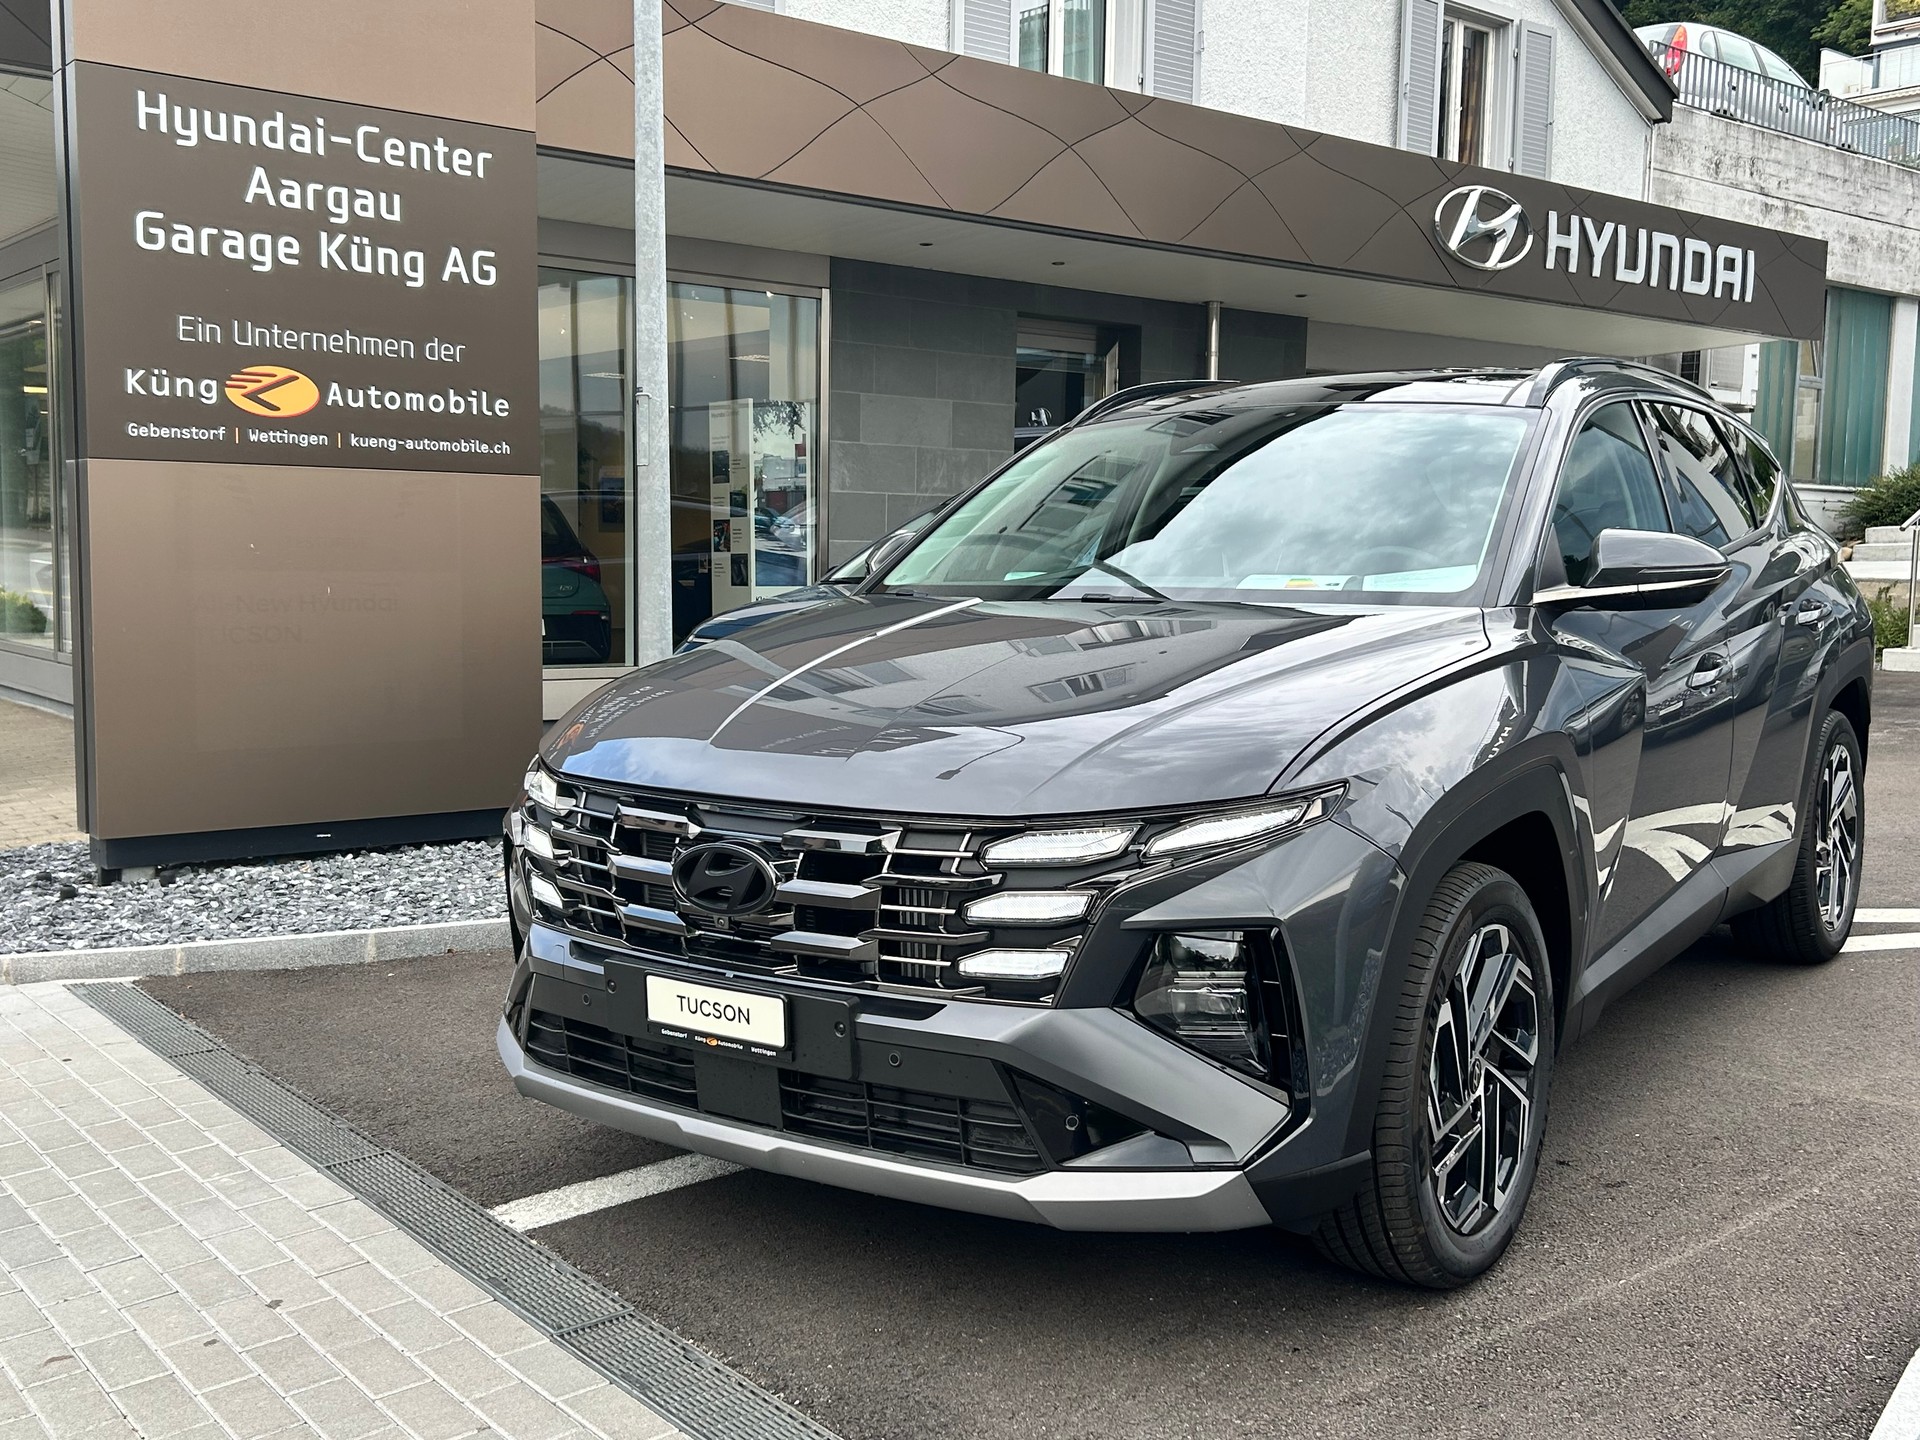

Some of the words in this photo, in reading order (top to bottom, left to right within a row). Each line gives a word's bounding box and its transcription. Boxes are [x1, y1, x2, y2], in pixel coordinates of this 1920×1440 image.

[137, 89, 493, 179] Hyundai-Center
[244, 166, 401, 225] Aargau
[135, 210, 300, 272] Garage
[320, 231, 425, 288] Küng
[441, 246, 497, 286] AG
[1545, 210, 1755, 303] HYUNDAI
[177, 315, 221, 344] Ein
[233, 320, 415, 360] Unternehmen
[425, 337, 466, 363] der
[125, 368, 218, 405] Küng
[326, 382, 510, 417] Automobile
[127, 422, 226, 441] Gebenstorf
[248, 428, 328, 447] Wettingen
[350, 433, 511, 455] kueng-automobile.ch
[676, 994, 750, 1025] TUCSON
